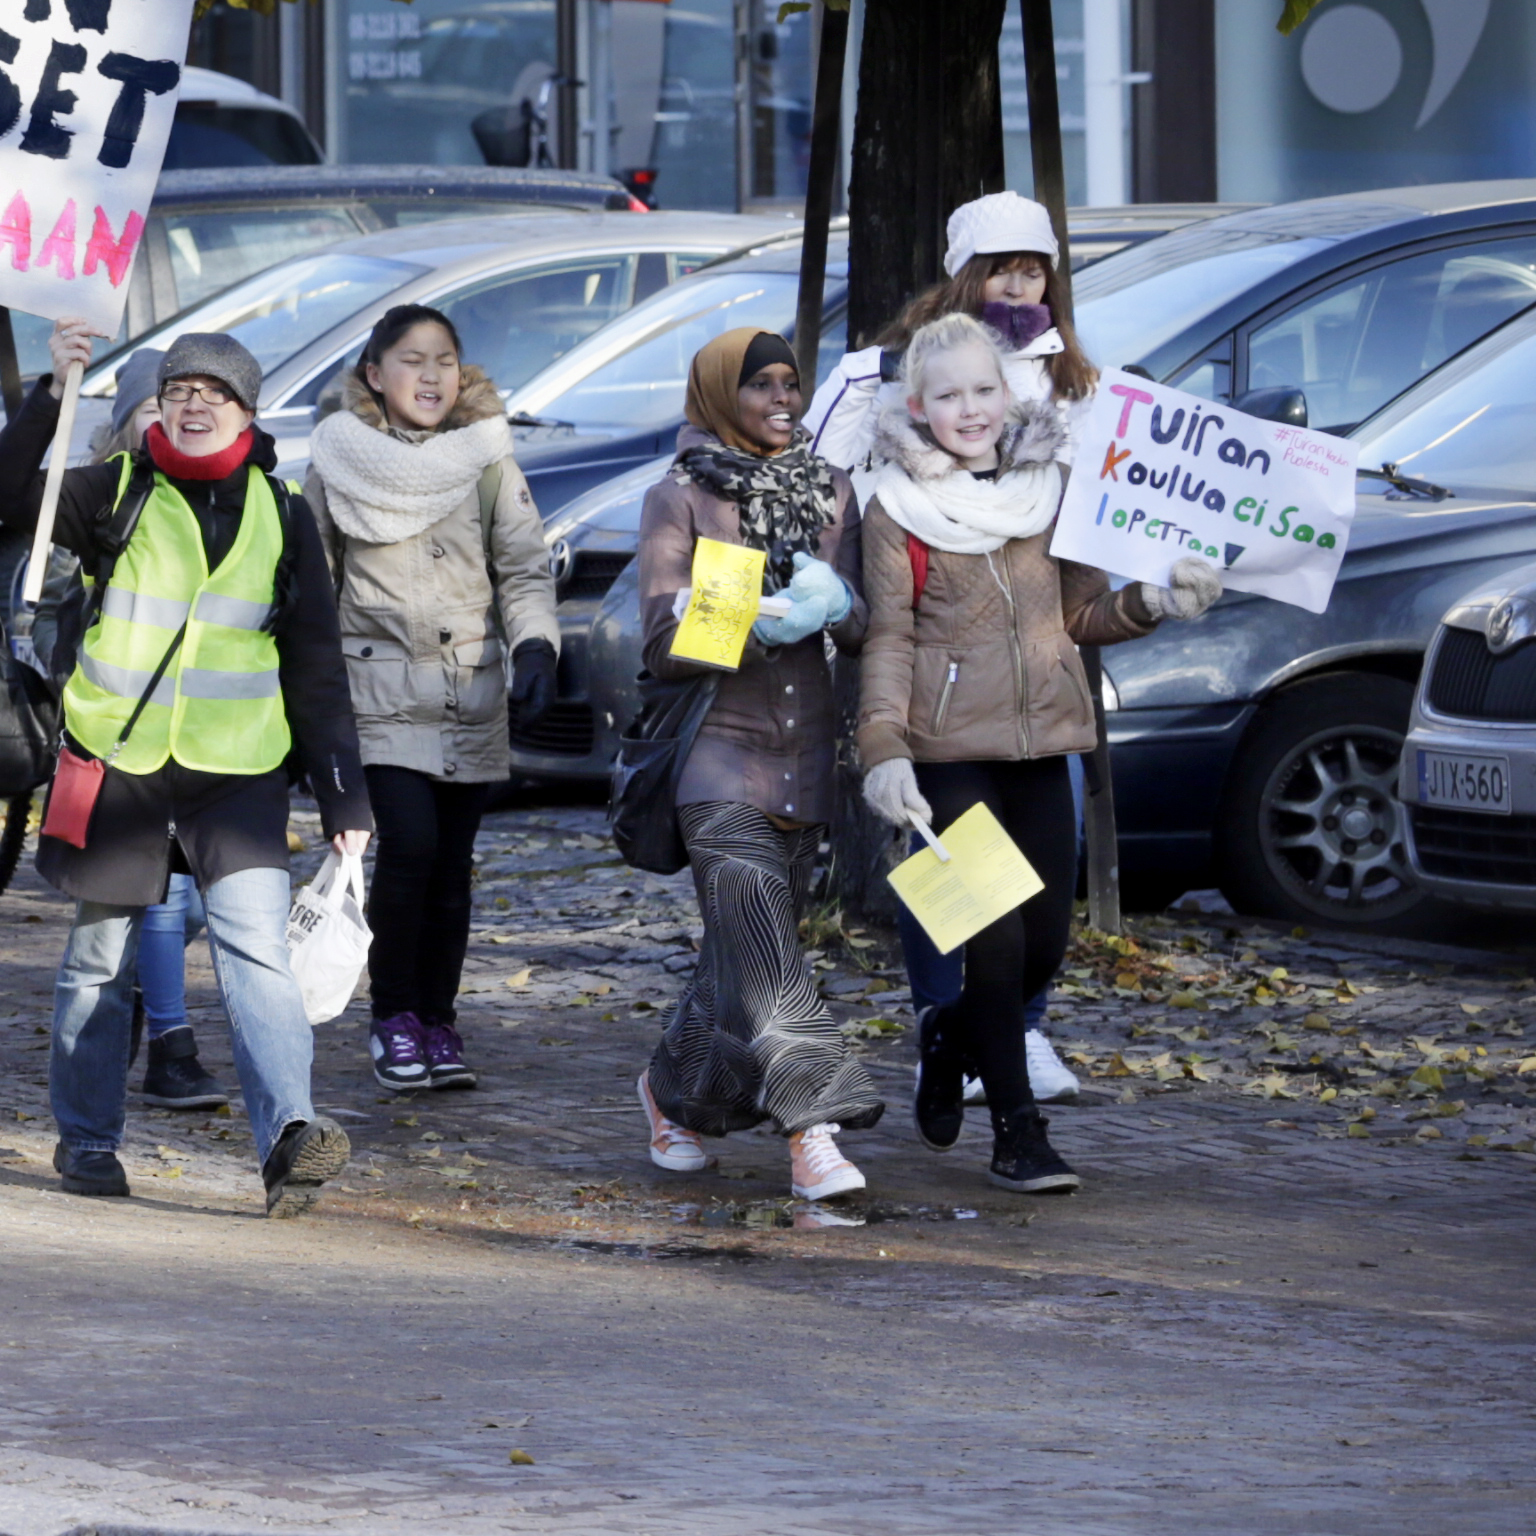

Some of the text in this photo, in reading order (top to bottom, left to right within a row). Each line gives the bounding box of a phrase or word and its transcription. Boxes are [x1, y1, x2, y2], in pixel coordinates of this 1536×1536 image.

[1109, 384, 1271, 476] Tuiran
[1232, 496, 1269, 527] ei
[1429, 759, 1504, 804] JIX-560
